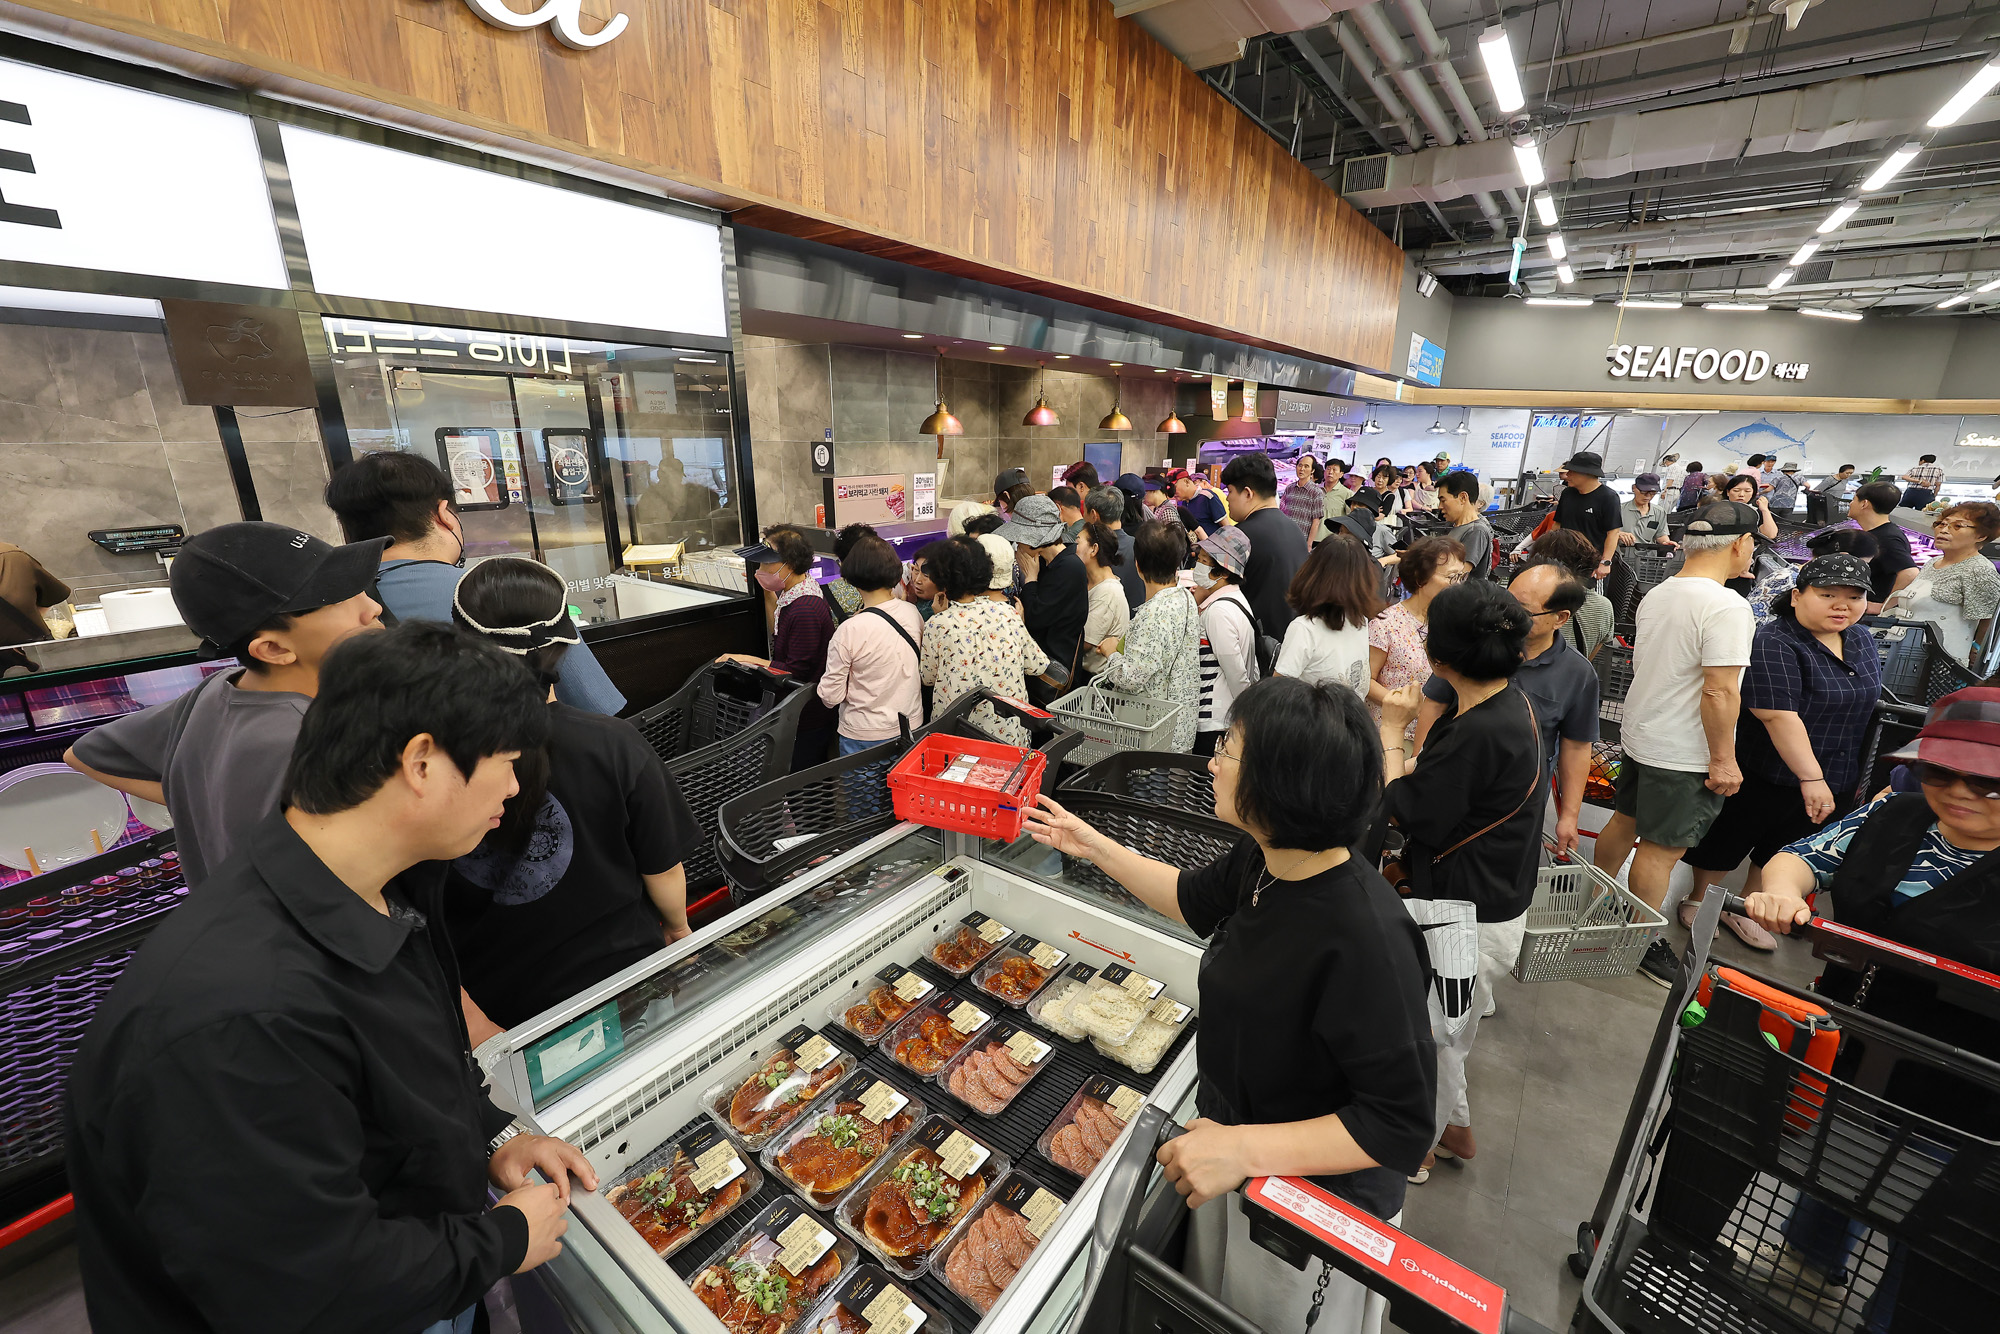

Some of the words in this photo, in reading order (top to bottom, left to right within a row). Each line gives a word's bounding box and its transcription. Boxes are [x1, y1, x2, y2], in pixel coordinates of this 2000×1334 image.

[1609, 344, 1771, 381] SEAFOOD
[1774, 362, 1810, 380] 해산물
[1490, 432, 1525, 440] SEAFOOD
[1491, 441, 1521, 449] MARKET
[556, 458, 585, 467] 직원전용
[848, 488, 868, 497] 보리먹고
[869, 487, 879, 496] 자란
[879, 487, 889, 495] 돼지
[567, 578, 591, 593] 위별
[593, 574, 615, 589] 맞춤
[662, 564, 690, 579] 용도별
[1421, 1269, 1488, 1312] Homeplus
